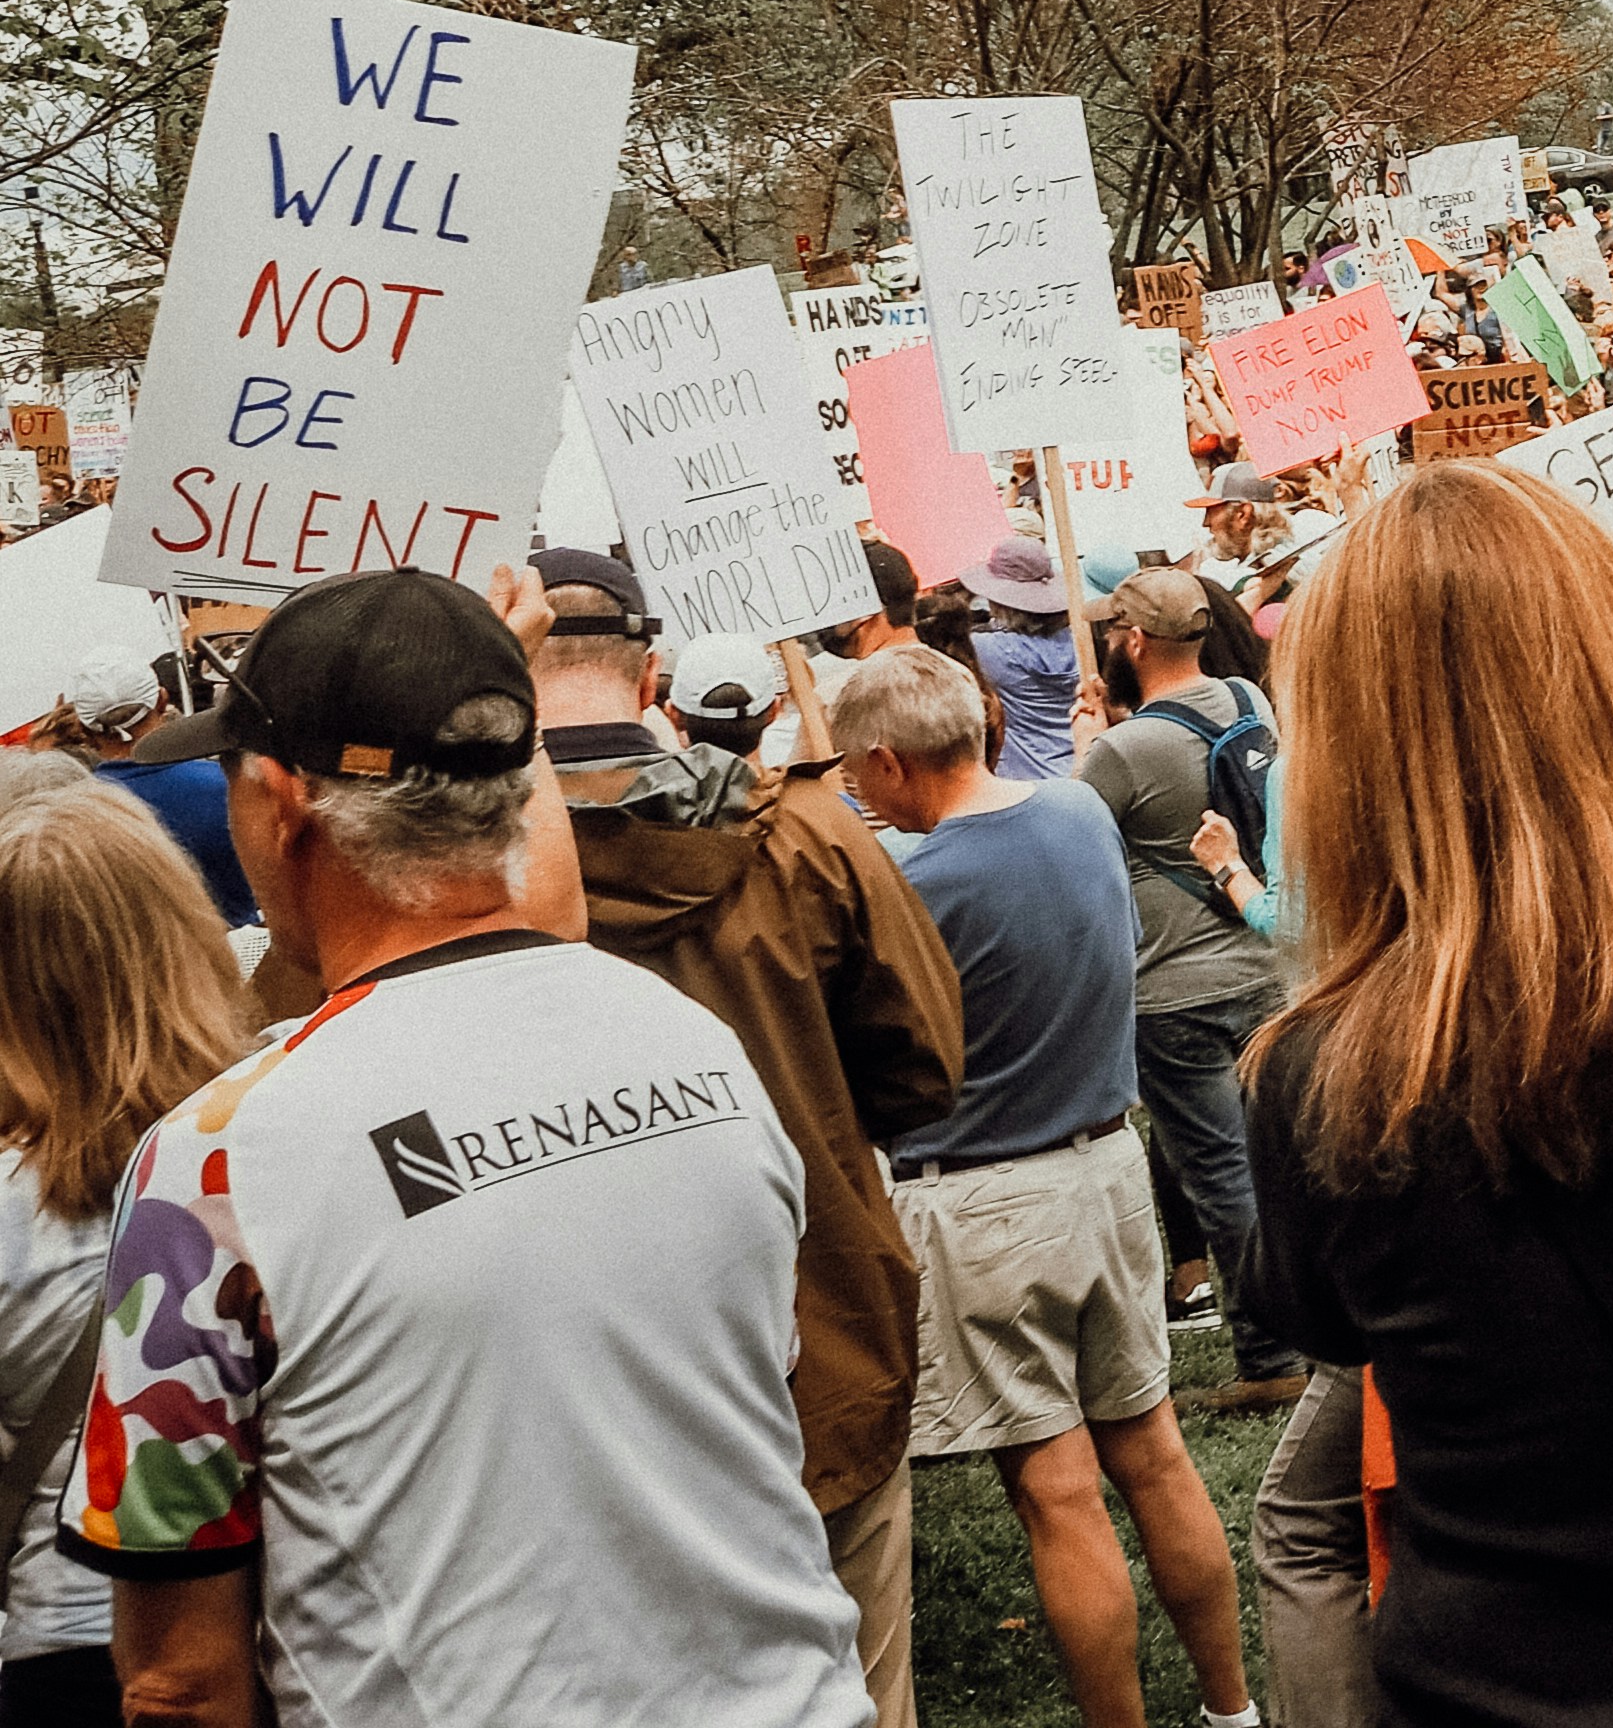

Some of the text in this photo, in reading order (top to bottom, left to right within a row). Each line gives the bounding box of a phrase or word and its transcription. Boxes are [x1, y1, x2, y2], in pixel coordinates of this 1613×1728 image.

[331, 17, 471, 126] WE
[949, 112, 1020, 160] THE
[269, 131, 469, 243] WILL
[916, 174, 1082, 216] TWILIGHT
[973, 218, 1047, 258] ZONE
[1430, 216, 1471, 232] CHOICE
[1440, 208, 1452, 218] BY
[1443, 228, 1469, 240] NOT
[1140, 266, 1192, 302] HANDS
[1204, 283, 1270, 307] equality
[239, 259, 444, 365] NOT
[577, 296, 721, 373] Angry
[806, 292, 884, 333] HANDS
[1150, 303, 1188, 326] OFF
[1217, 304, 1262, 324] is for
[1232, 338, 1294, 384] FIRE
[1301, 308, 1369, 356] ELON
[606, 368, 767, 445] Women
[960, 361, 1043, 411] ENDING
[1245, 350, 1374, 416] DUMP TRUMP
[1427, 374, 1537, 411] SCIENCE
[228, 376, 355, 450] BE
[1276, 392, 1347, 446] NOW
[1445, 410, 1521, 448] NOT
[675, 441, 759, 491] WILL
[152, 467, 499, 581] SILENT
[770, 483, 829, 533] the
[661, 528, 870, 641] WORLD!!!
[450, 1071, 741, 1182] RENASANT
